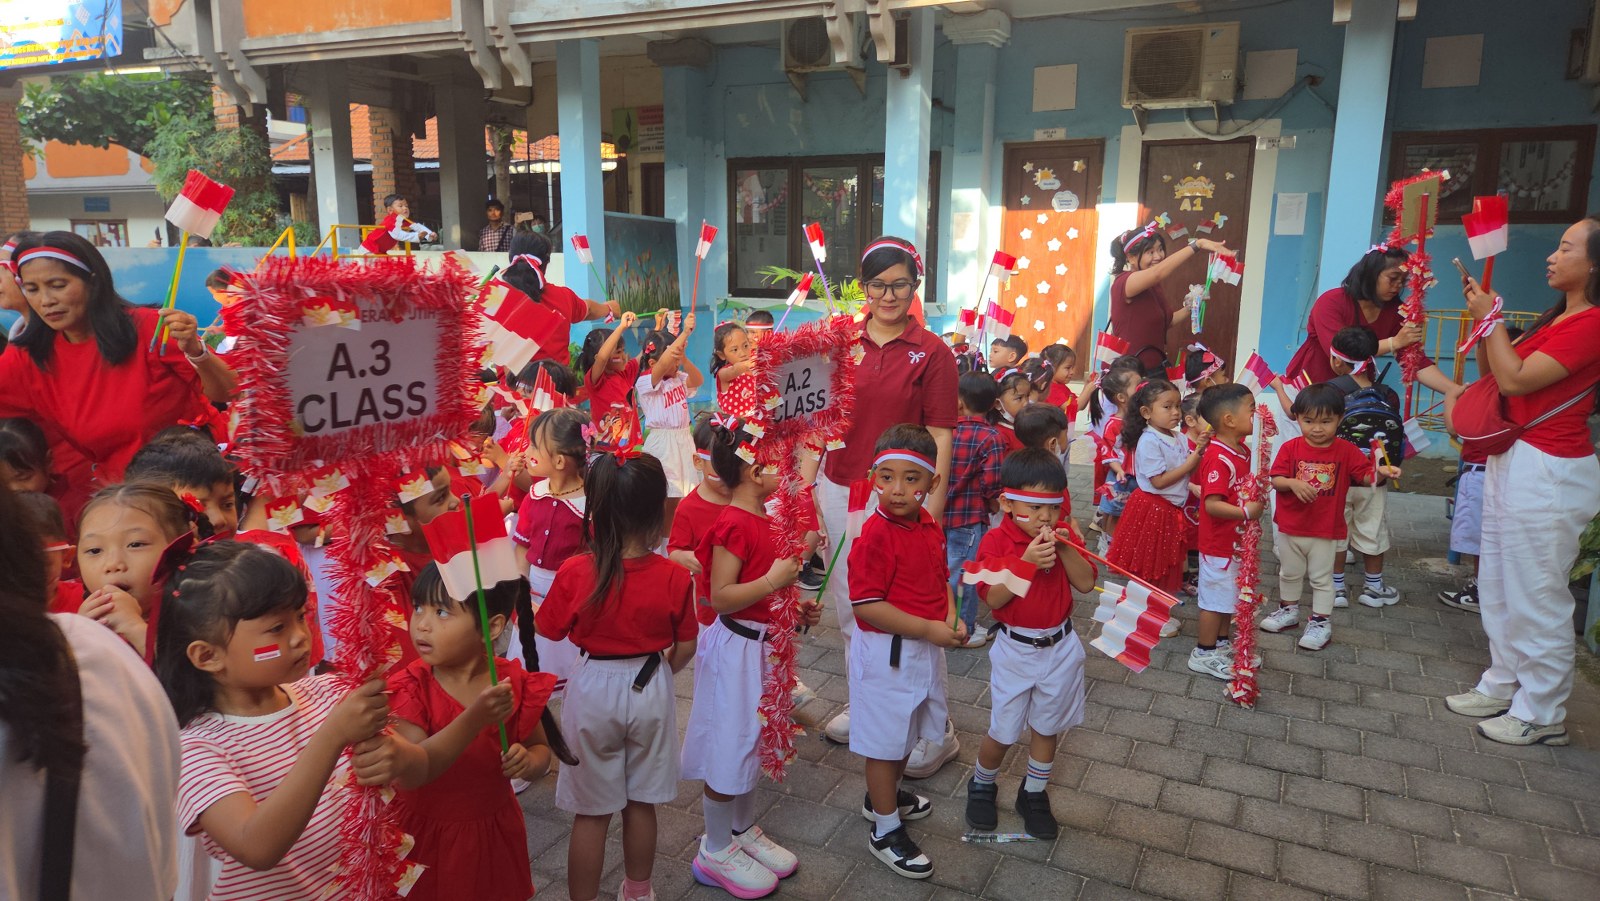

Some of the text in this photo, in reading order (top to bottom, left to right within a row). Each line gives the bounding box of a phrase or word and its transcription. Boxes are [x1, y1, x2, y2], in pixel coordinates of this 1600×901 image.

[326, 339, 391, 381] A.3
[784, 367, 812, 395] A.2
[297, 381, 427, 433] CLASS
